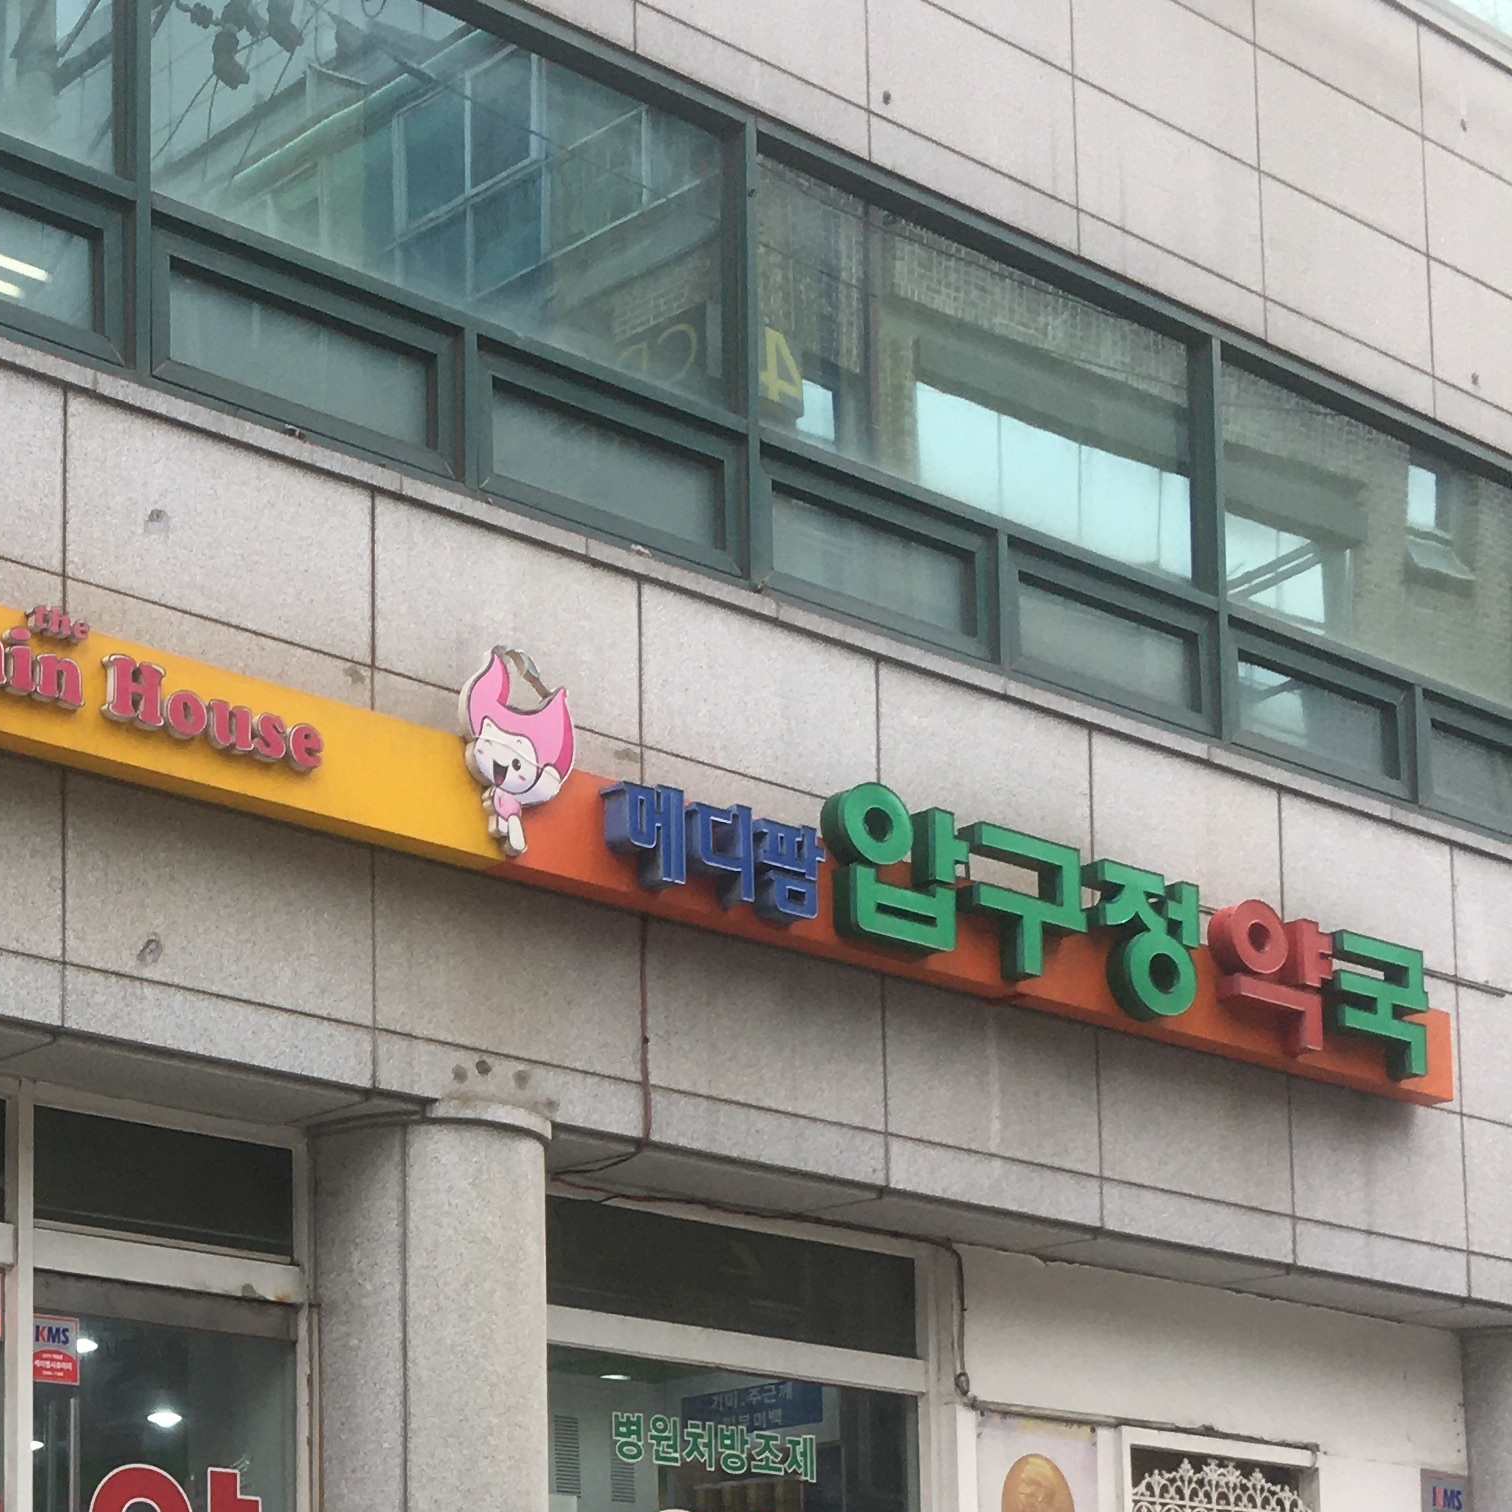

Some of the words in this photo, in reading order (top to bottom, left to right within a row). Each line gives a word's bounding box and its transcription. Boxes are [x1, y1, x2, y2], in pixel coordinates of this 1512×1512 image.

[26, 604, 89, 641] the
[100, 652, 324, 774] House
[601, 780, 825, 924] 메디팜
[821, 781, 1429, 1079] 압구정약국
[35, 1325, 69, 1345] KMS
[612, 1411, 817, 1483] 병원처방조제
